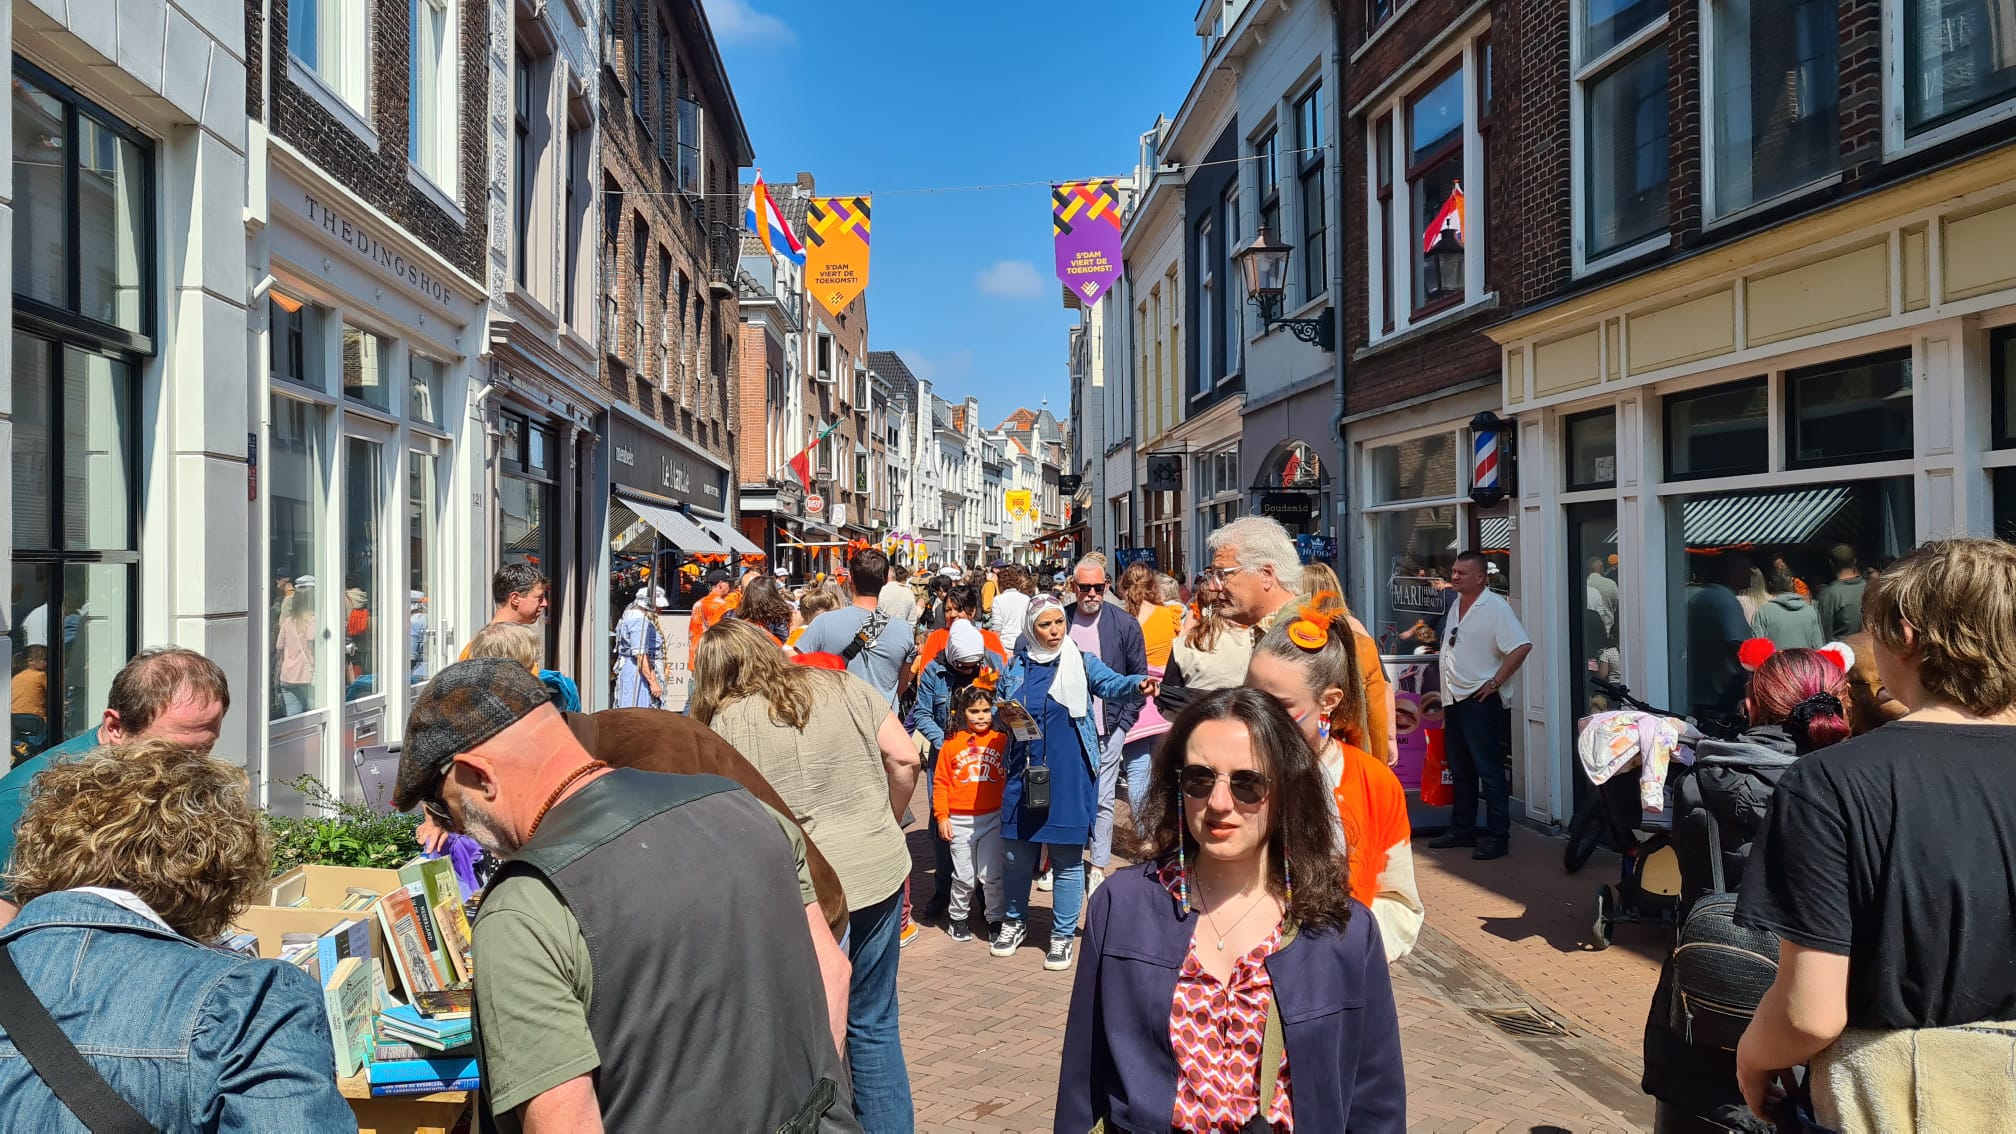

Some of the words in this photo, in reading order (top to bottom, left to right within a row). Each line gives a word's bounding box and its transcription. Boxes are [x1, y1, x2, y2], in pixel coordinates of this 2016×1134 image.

[305, 194, 451, 306] THEDINGSHOF
[1071, 259, 1094, 267] VIERT
[1066, 265, 1113, 275] TOEKOMST!
[472, 492, 482, 505] 121
[1264, 503, 1309, 512] Goudsmid
[1394, 584, 1422, 606] MARI
[1396, 737, 1409, 745] ARI
[420, 904, 433, 942] NEDERLAND
